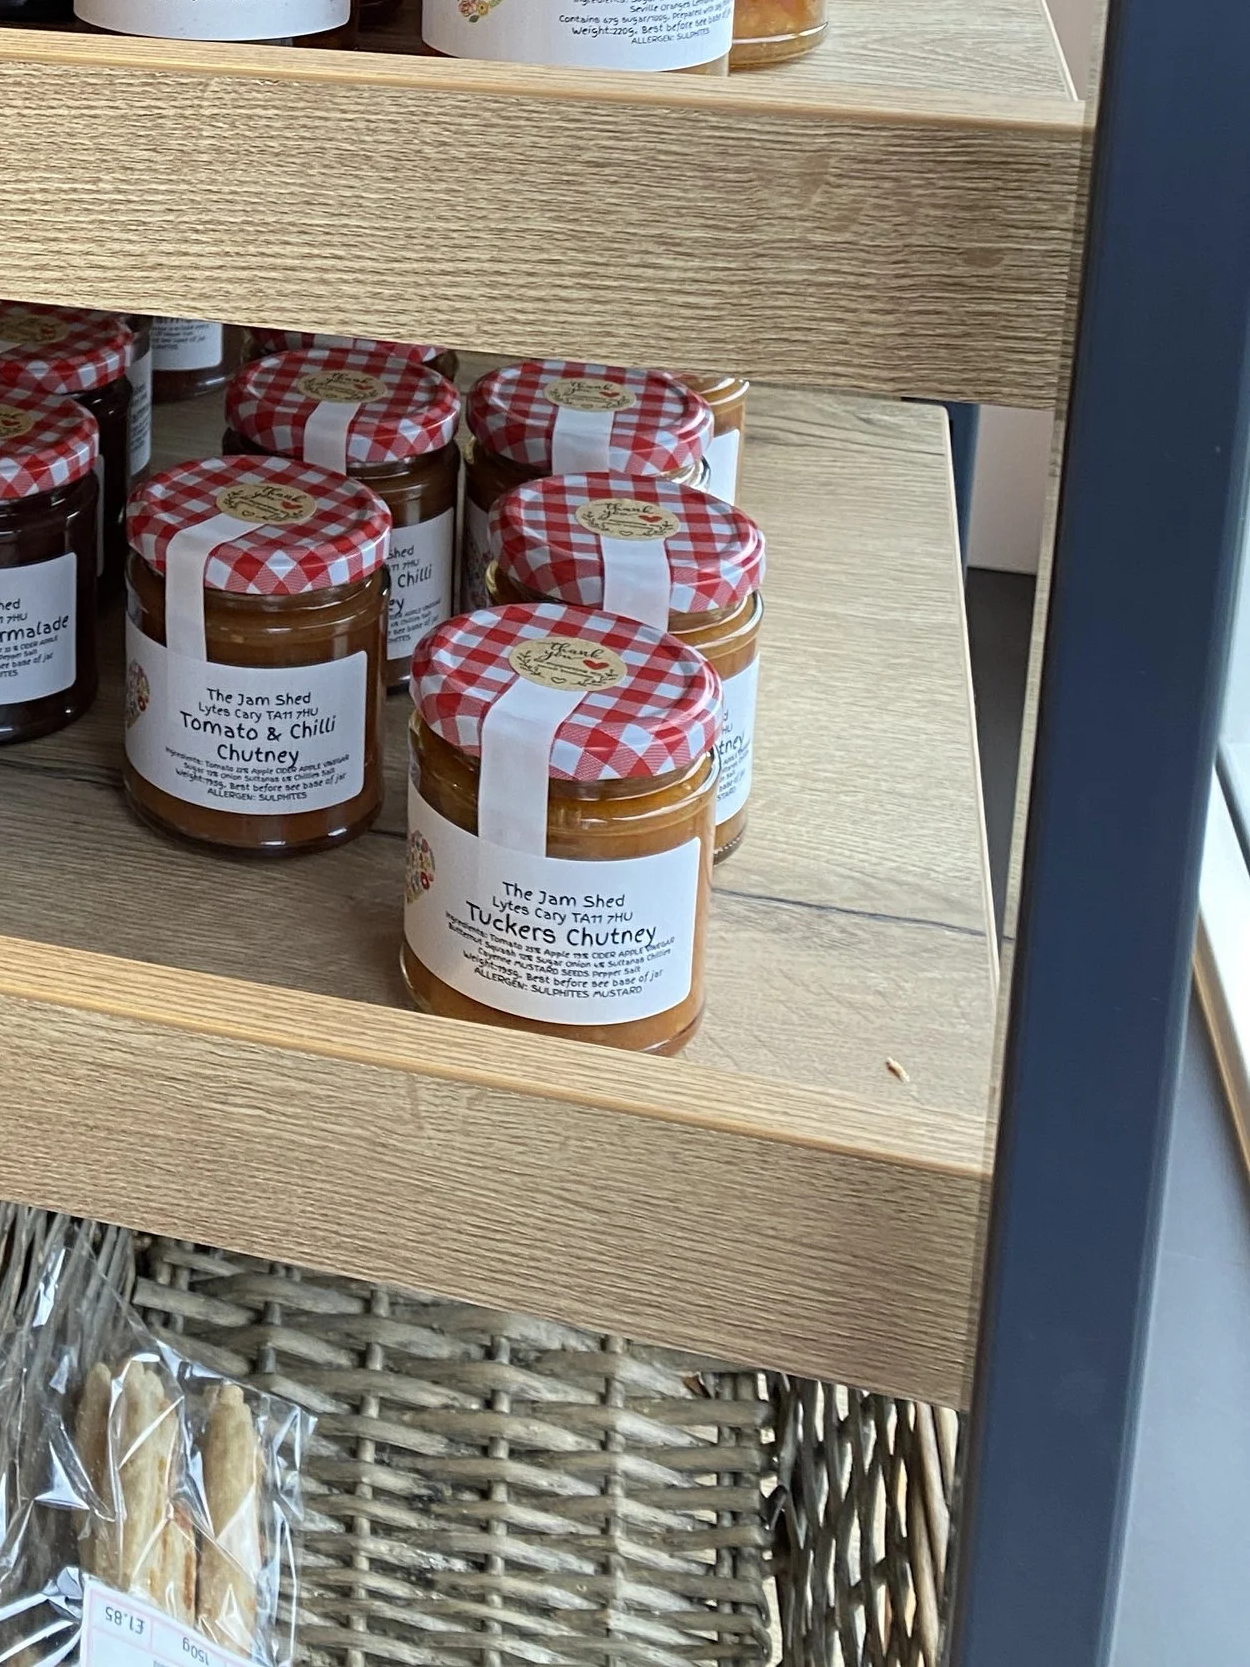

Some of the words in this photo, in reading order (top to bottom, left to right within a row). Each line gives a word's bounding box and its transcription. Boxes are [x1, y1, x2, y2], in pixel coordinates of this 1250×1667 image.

[398, 564, 432, 587] Chilli
[207, 688, 233, 703] The
[238, 694, 270, 705] Jam
[276, 692, 311, 705] Shed
[180, 711, 258, 740] Tomato
[267, 727, 281, 741] &
[291, 716, 336, 739] Chilli
[199, 702, 230, 716] Lytes
[235, 709, 262, 723] Cary
[218, 744, 299, 768] Chutney
[502, 882, 533, 901] The
[539, 891, 576, 906] Jam
[583, 894, 625, 908] Shed
[466, 901, 556, 944] Tuckers
[567, 927, 656, 947] Chutney
[493, 896, 529, 916] Lytes
[535, 908, 566, 925] Cary
[474, 967, 528, 990] ALLERGEN:
[532, 985, 589, 998] SULPHITES
[105, 1606, 145, 1635] £1.85
[182, 1637, 209, 1666] 150g
